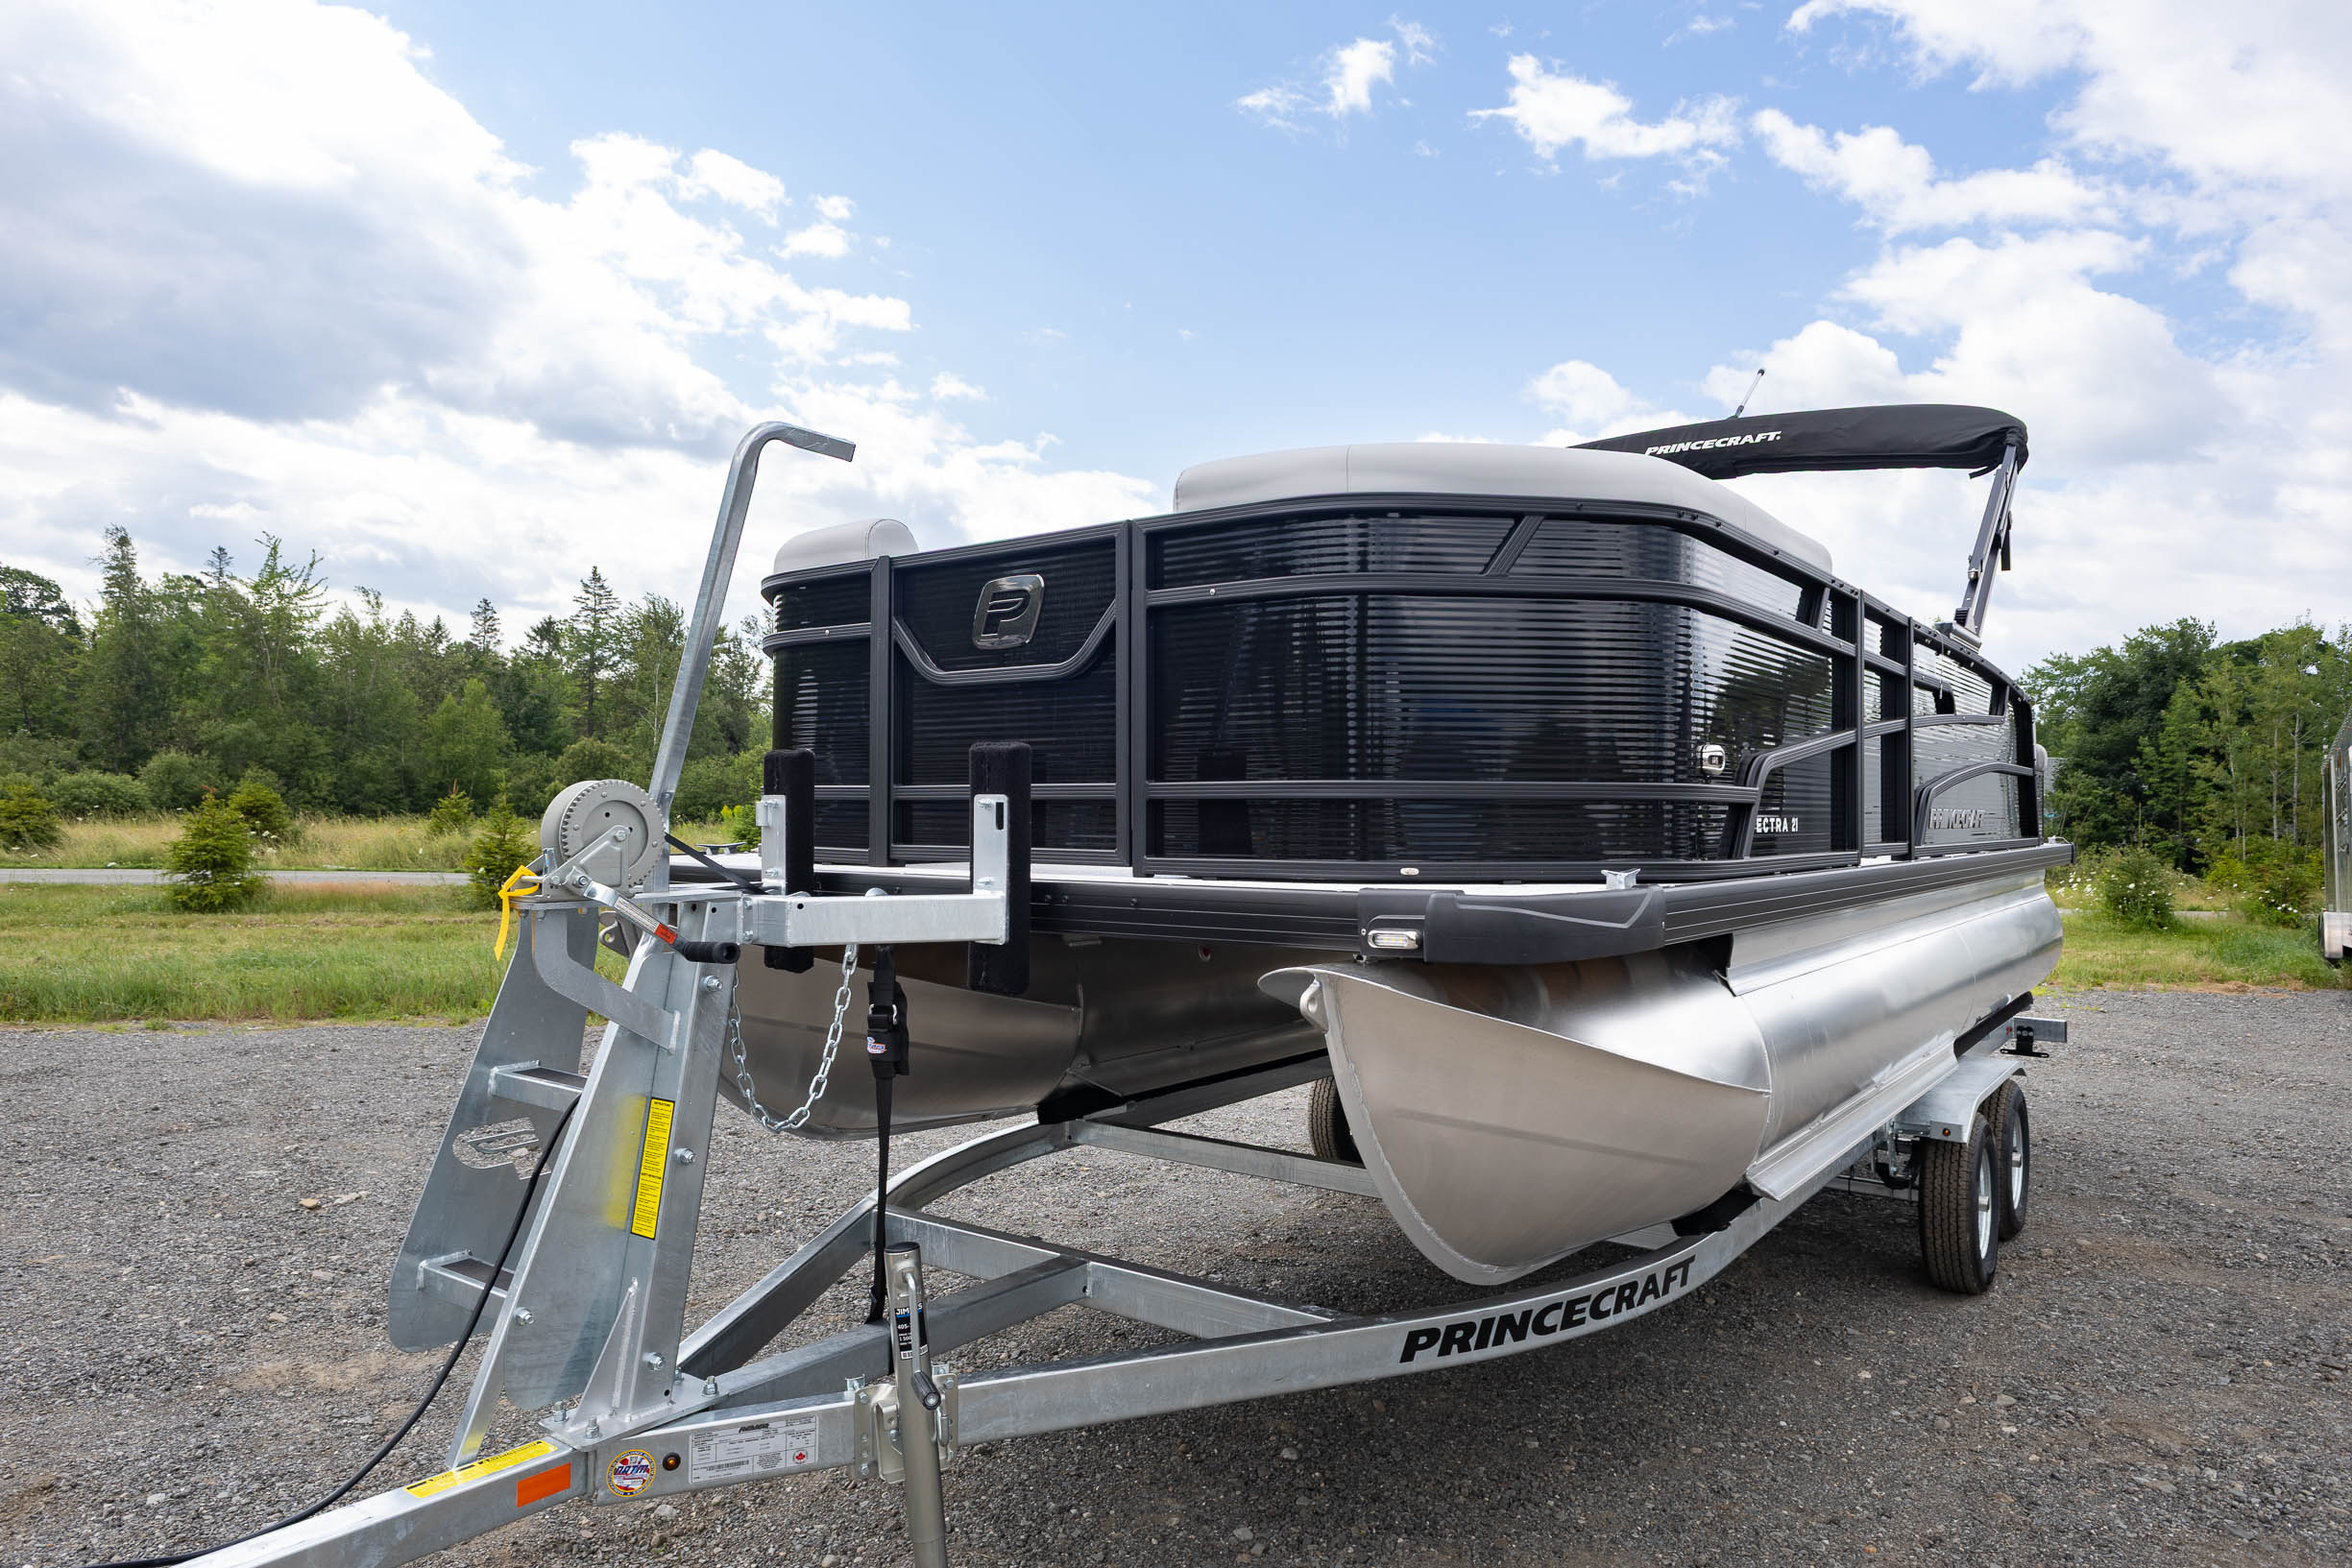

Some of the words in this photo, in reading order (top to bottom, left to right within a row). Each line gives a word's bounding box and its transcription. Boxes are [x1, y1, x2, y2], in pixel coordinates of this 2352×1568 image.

[1755, 817, 1789, 833] ECTRA
[1791, 817, 1799, 832] 21
[1399, 1255, 1696, 1363] PRINCECRAFT
